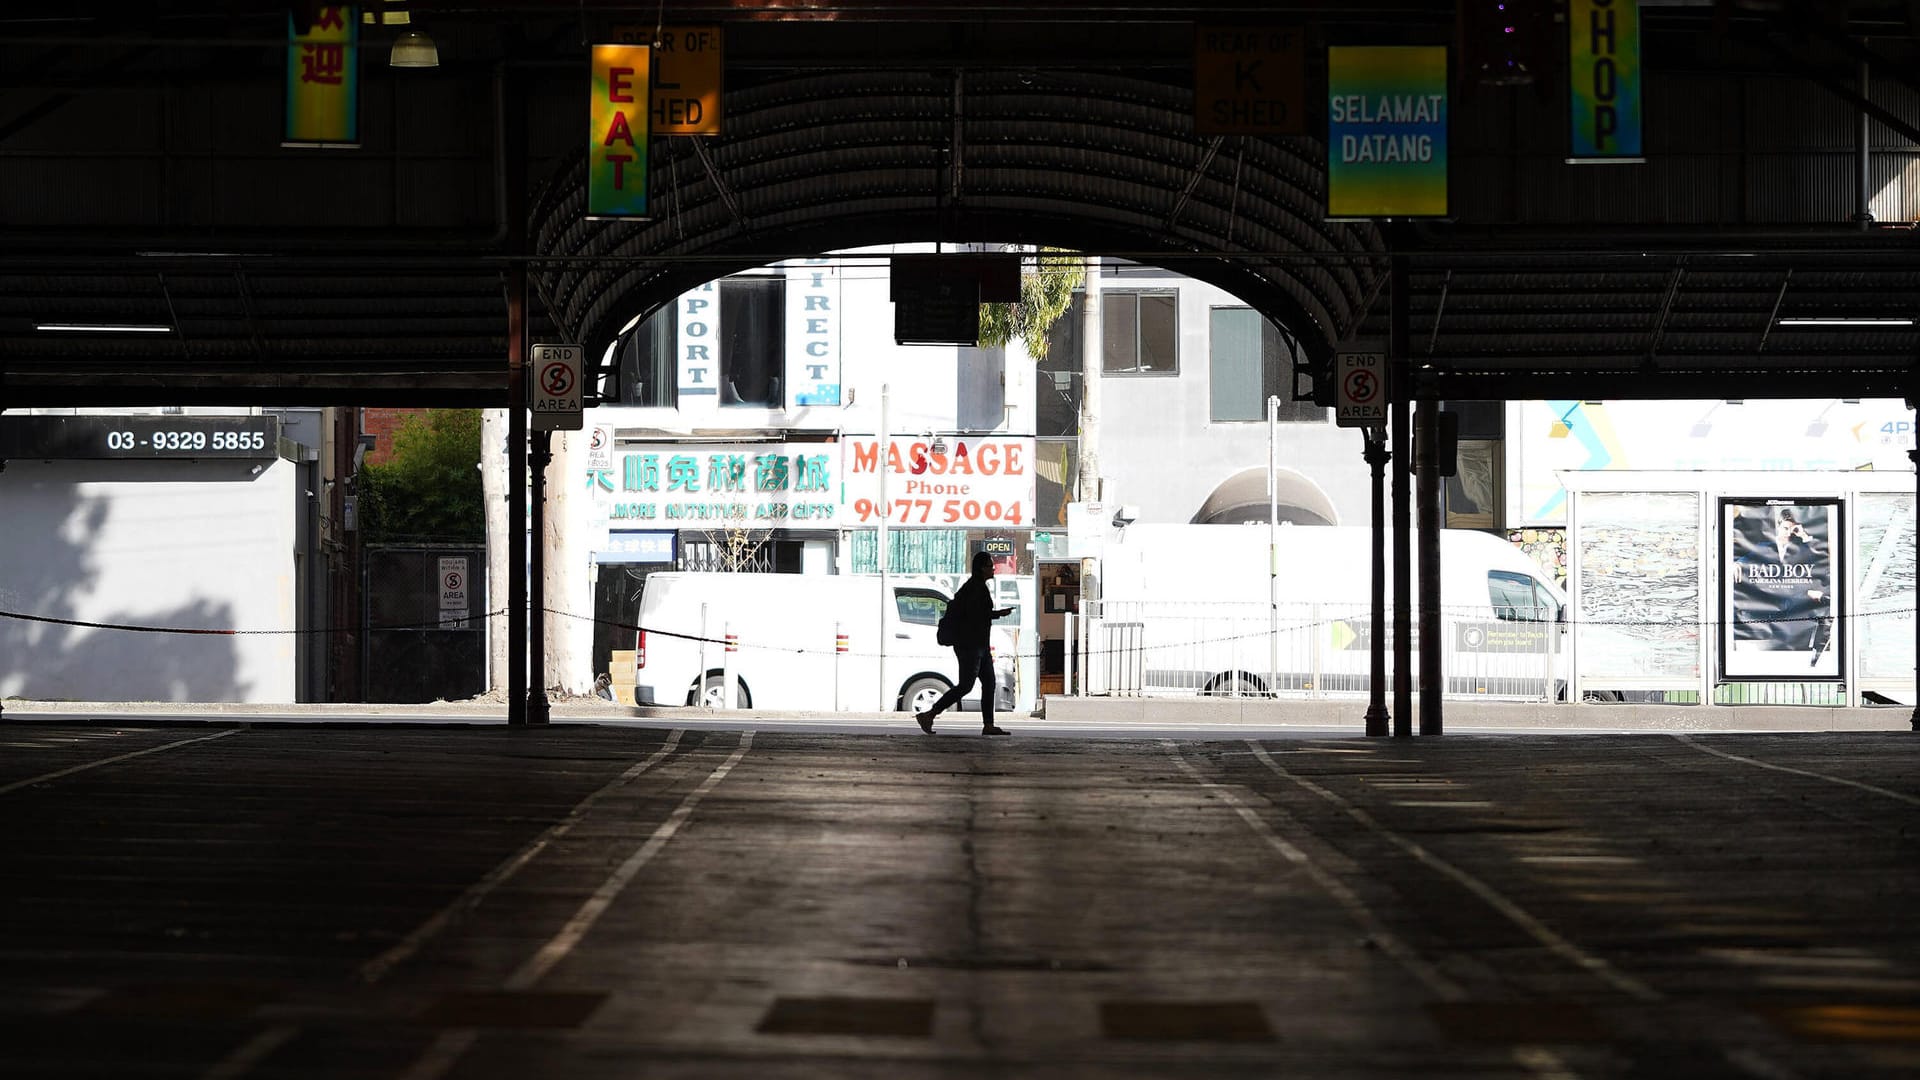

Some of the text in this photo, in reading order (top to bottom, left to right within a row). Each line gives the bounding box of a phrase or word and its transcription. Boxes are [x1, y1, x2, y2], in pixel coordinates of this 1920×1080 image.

[1234, 58, 1264, 93] K
[1591, 0, 1617, 149] HOP
[1212, 98, 1288, 127] SHED
[1331, 95, 1443, 123] SELAMAT
[605, 68, 634, 190] EAT
[1342, 134, 1433, 162] DATANG
[542, 349, 573, 360] END
[1346, 355, 1377, 367] END
[536, 400, 578, 410] AREA
[1341, 406, 1383, 417] AREA
[1880, 421, 1916, 434] 4P
[107, 431, 135, 449] 03
[152, 431, 207, 450] 9329
[212, 431, 265, 450] 5855
[853, 441, 1024, 476] MASSAGE
[906, 480, 970, 495] Phone
[610, 502, 835, 520] MORE NUTRITION AND GIFTS
[854, 498, 1023, 526] 9077 5004
[986, 542, 1011, 552] OPEN
[1749, 563, 1814, 577] BAD BOY
[443, 591, 464, 599] AREA
